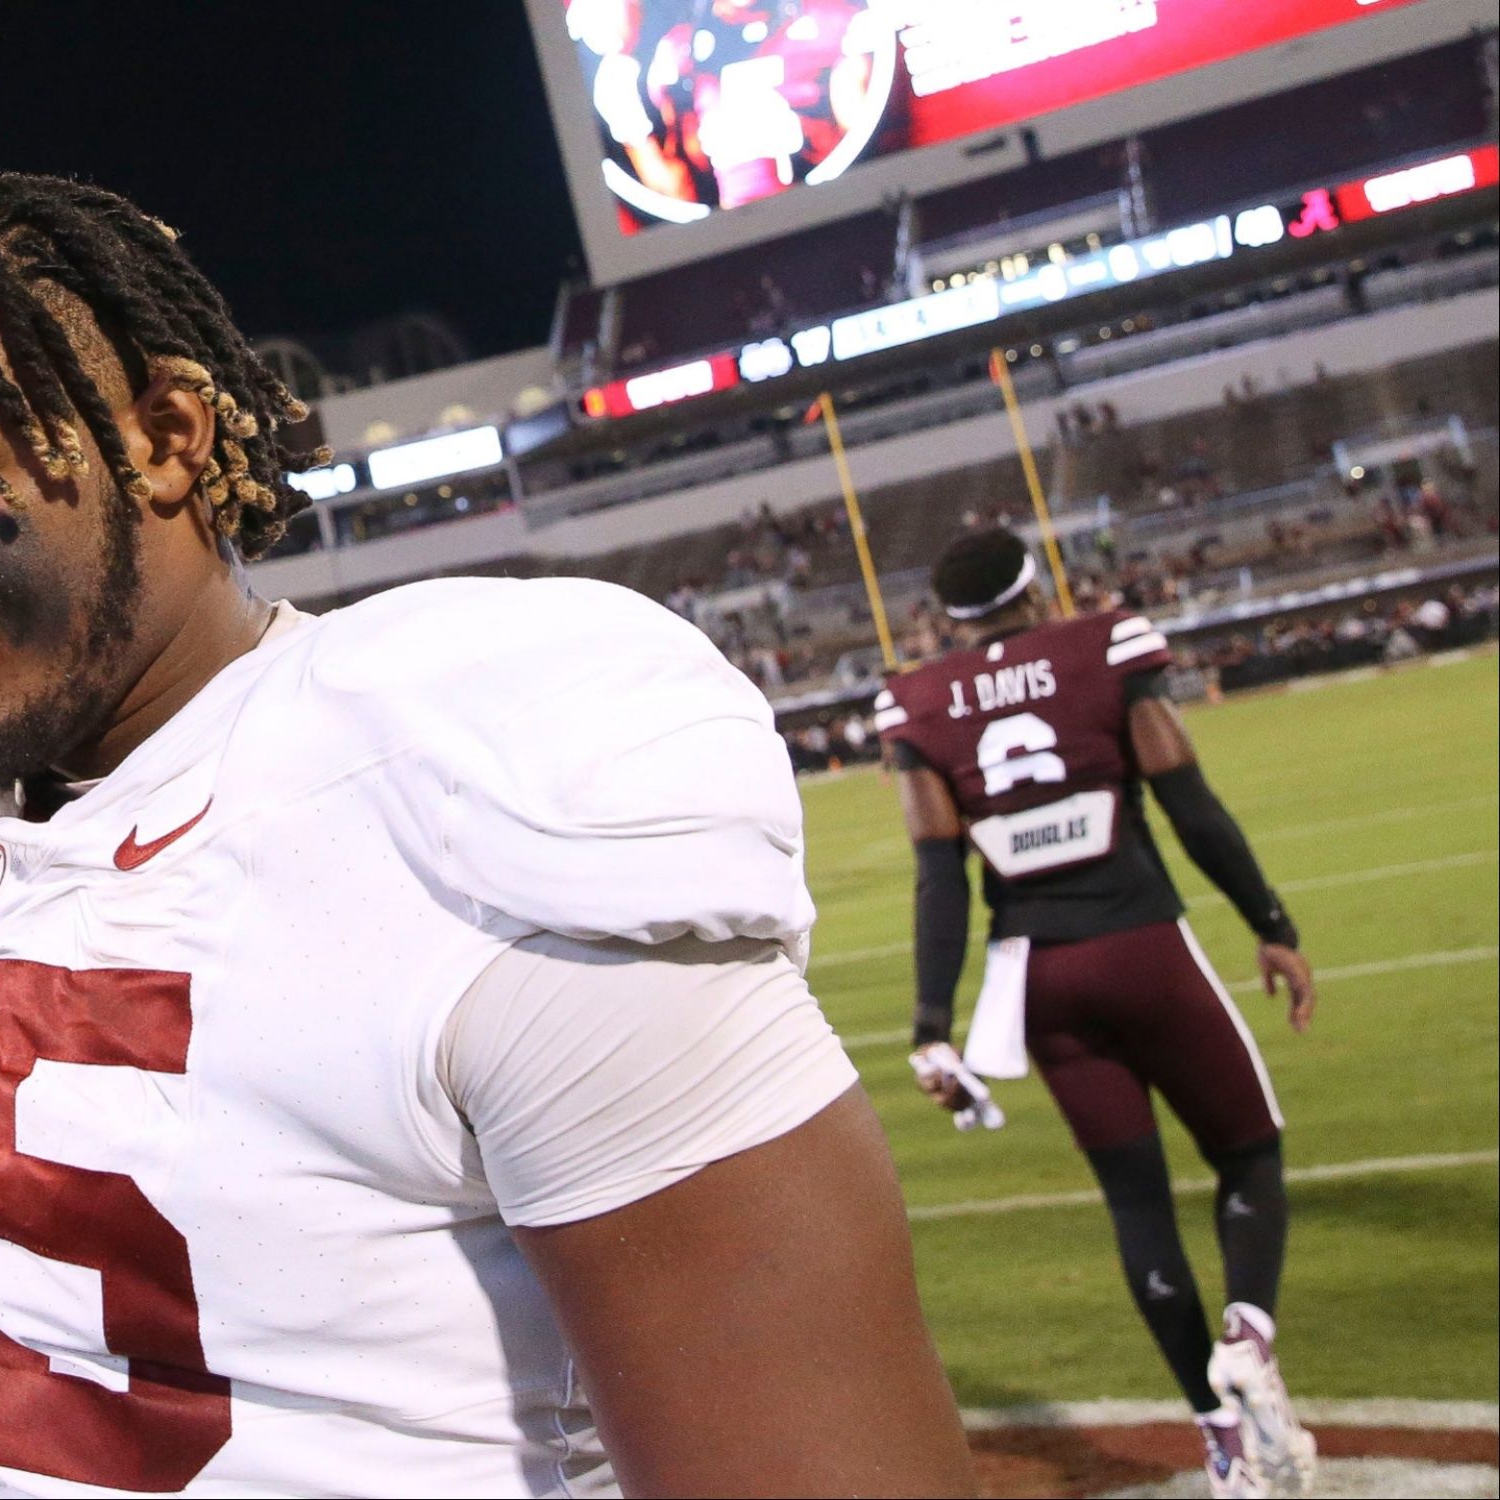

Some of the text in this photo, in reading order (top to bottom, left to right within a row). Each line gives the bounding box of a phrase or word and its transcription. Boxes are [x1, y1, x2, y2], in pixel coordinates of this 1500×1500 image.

[948, 658, 1057, 719] J. DAVIS
[1011, 816, 1087, 853] DOUGLAS
